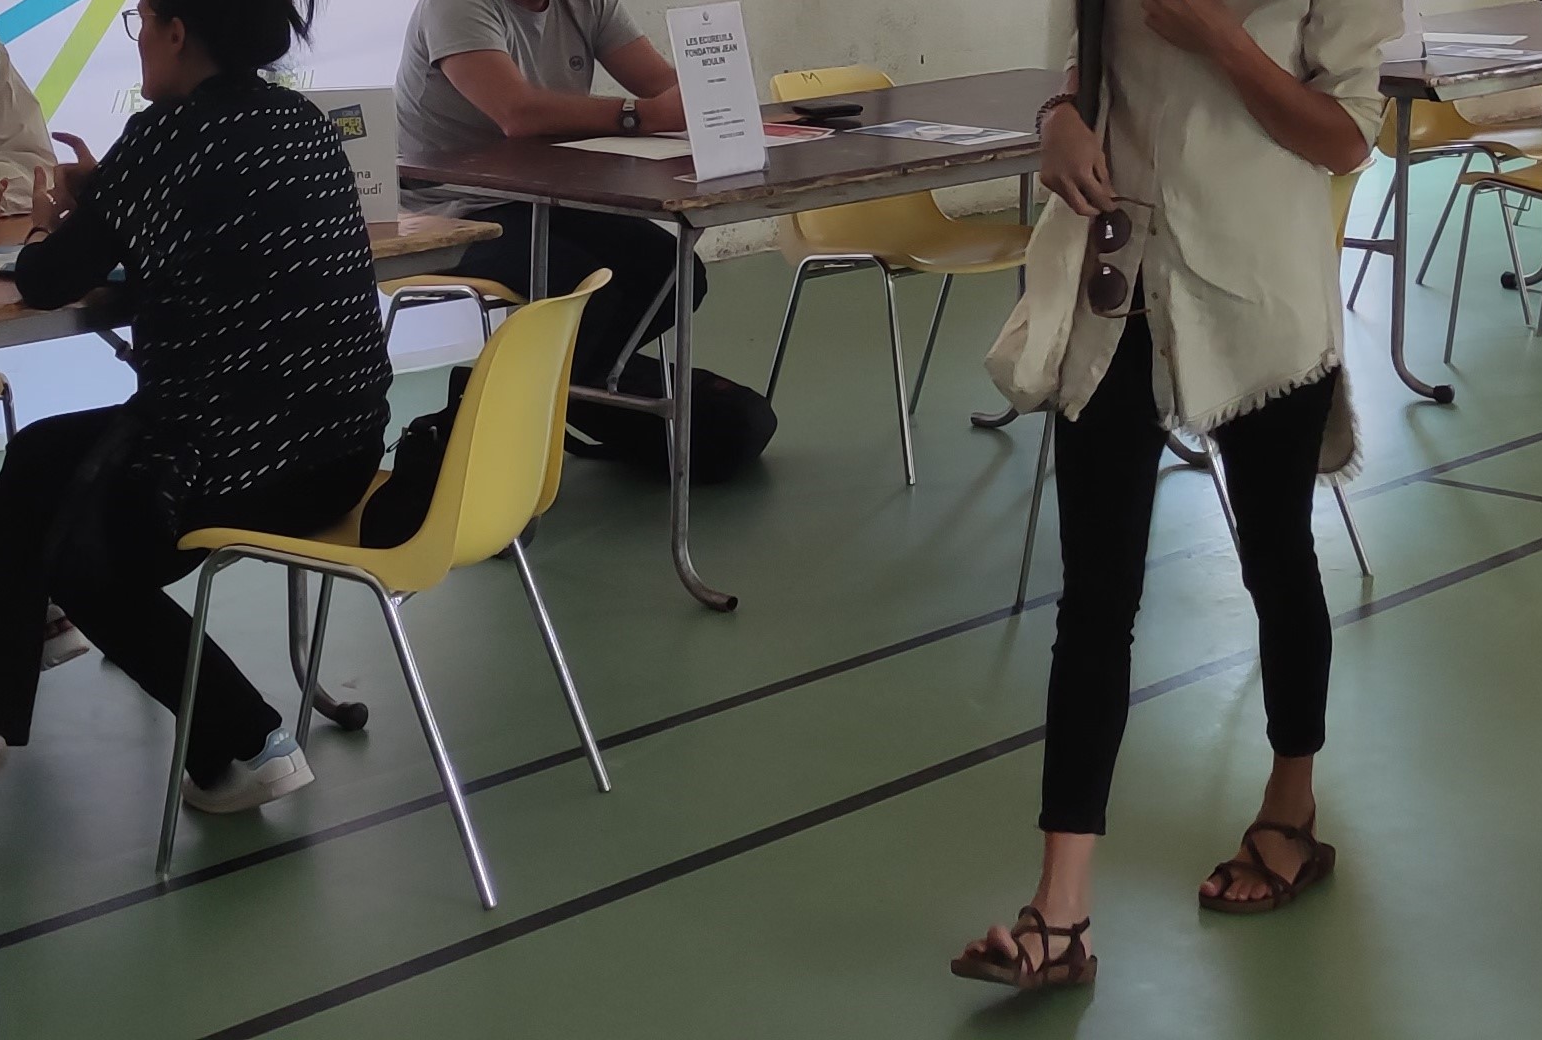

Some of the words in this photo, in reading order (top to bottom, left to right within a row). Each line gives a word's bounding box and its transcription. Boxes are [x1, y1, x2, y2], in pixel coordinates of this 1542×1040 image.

[685, 37, 699, 47] LES
[684, 46, 721, 58] FONDATION
[343, 126, 364, 136] PAS
